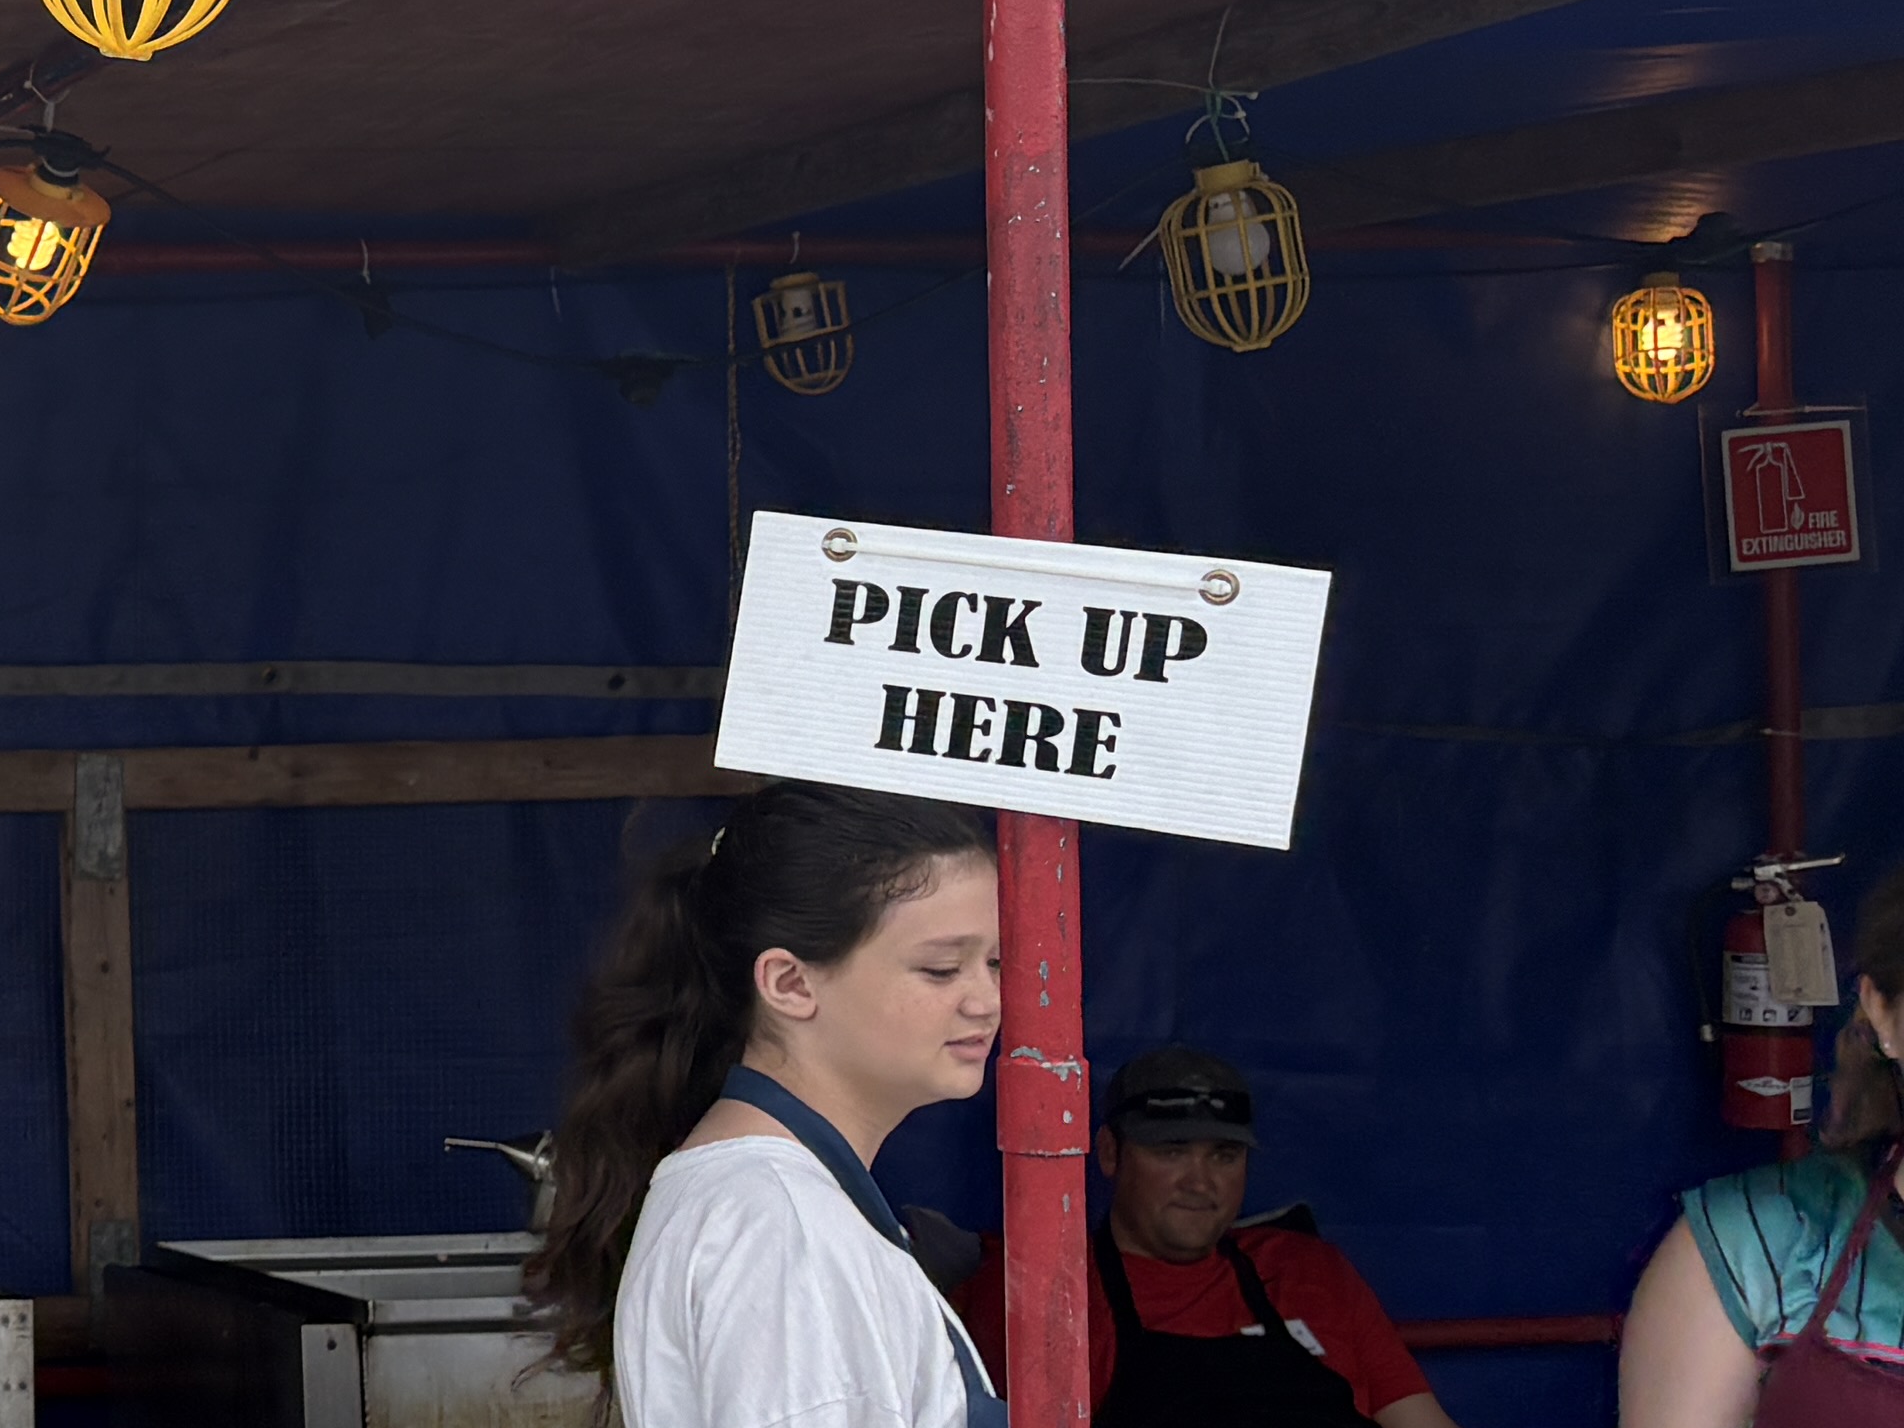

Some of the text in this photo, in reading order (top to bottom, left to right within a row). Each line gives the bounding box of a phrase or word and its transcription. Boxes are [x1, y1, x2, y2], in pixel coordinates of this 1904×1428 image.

[1742, 529, 1847, 555] EXTINGUISHER
[1808, 510, 1839, 529] FIRE
[824, 577, 1208, 683] PICK UP
[874, 683, 1123, 780] HERE
